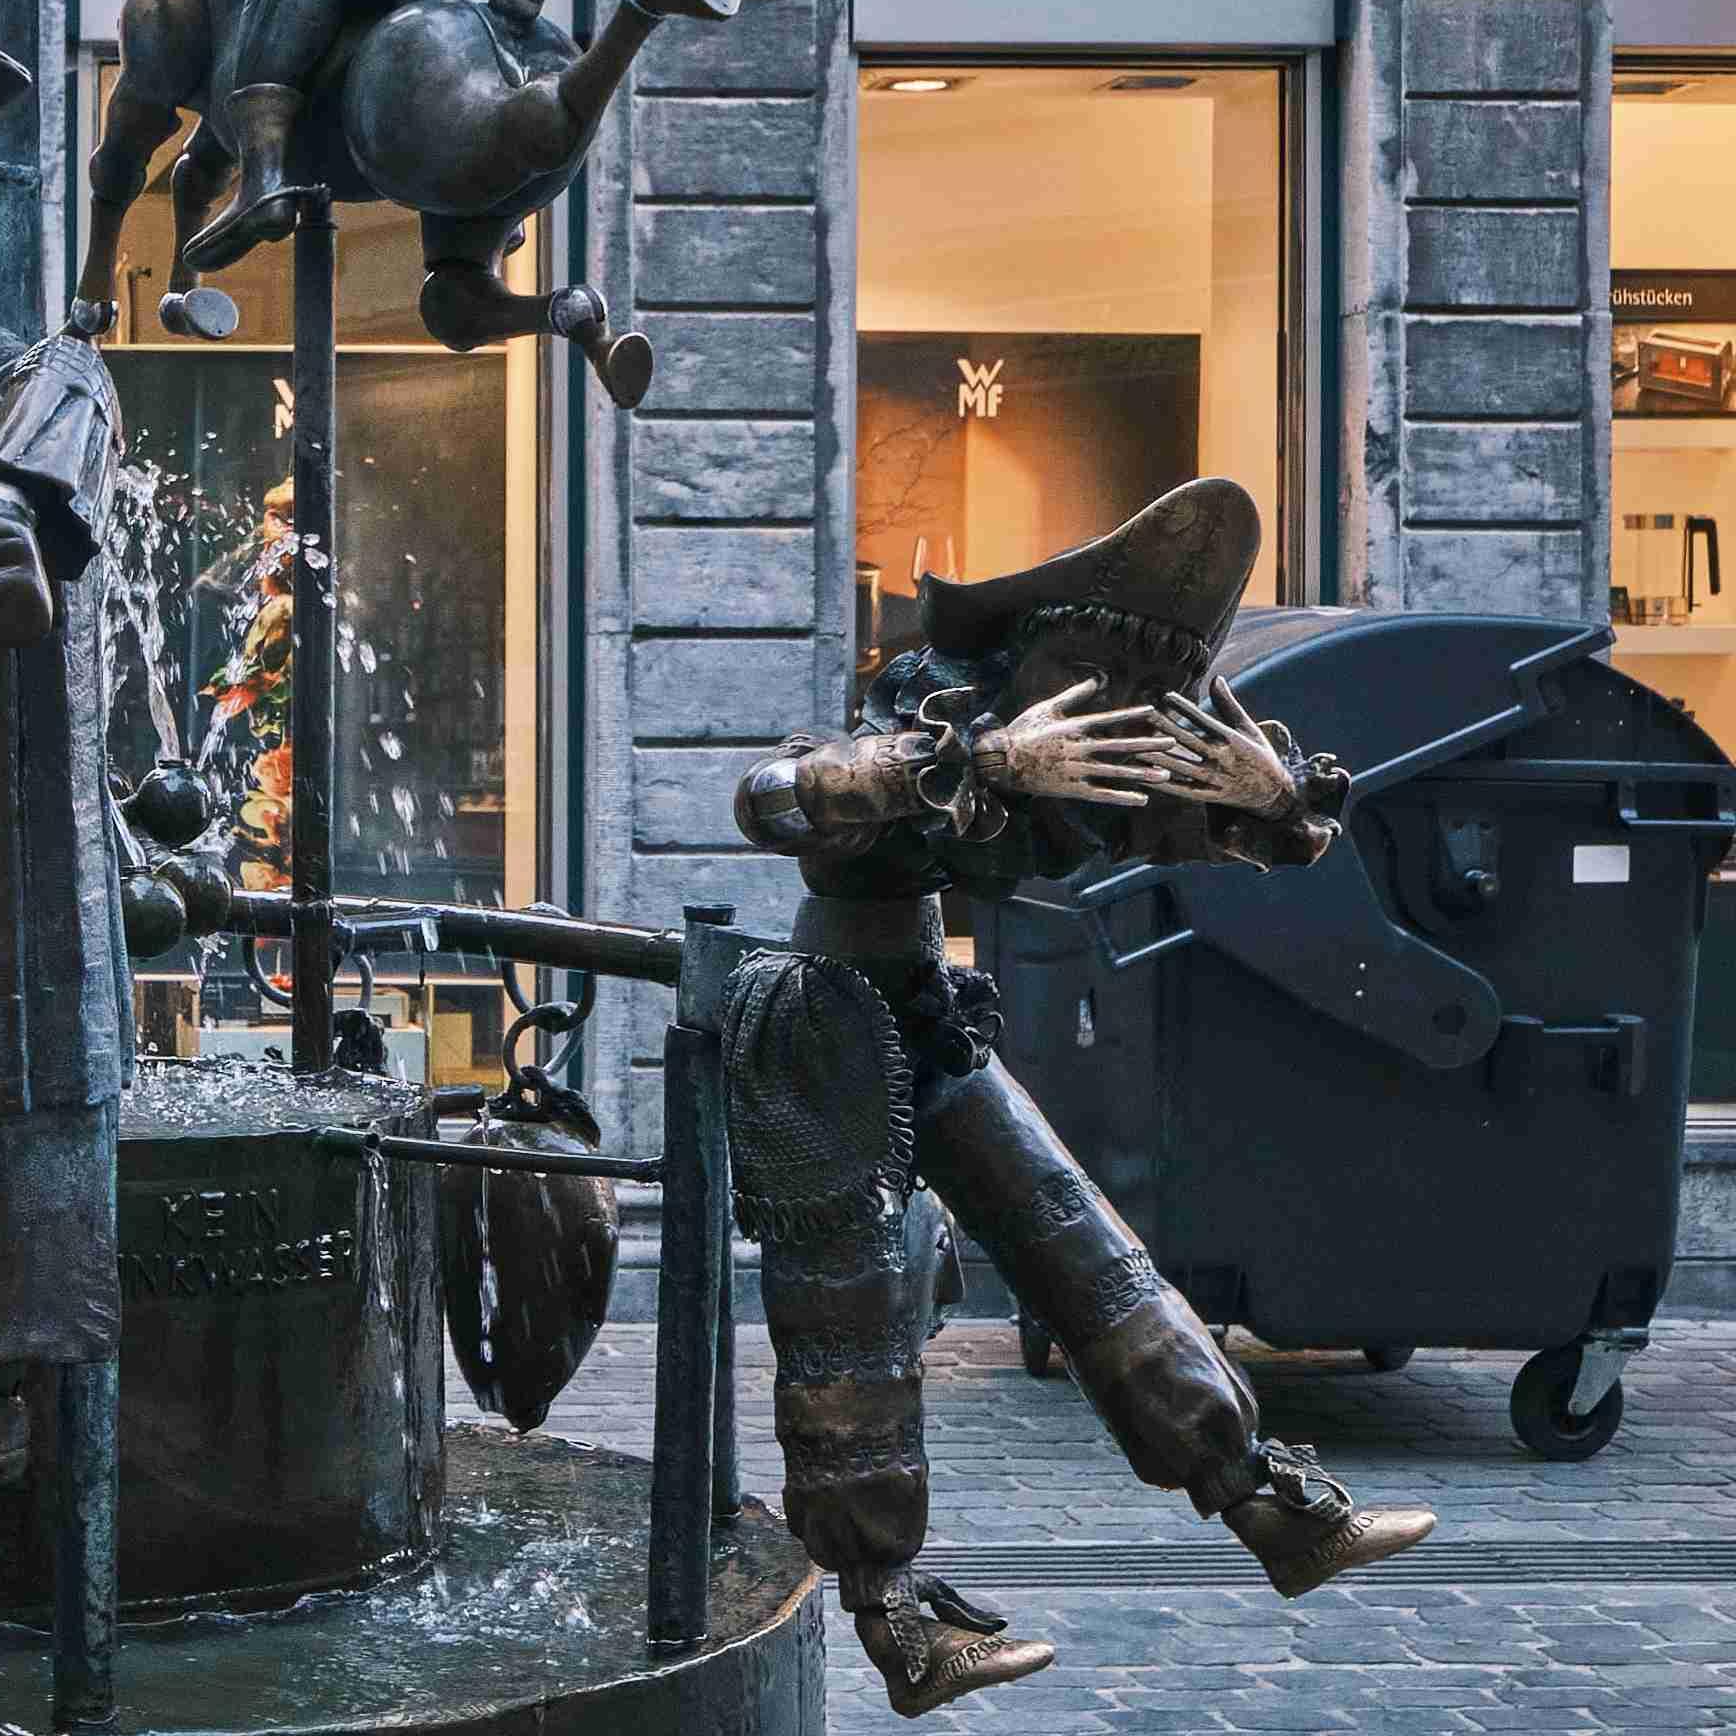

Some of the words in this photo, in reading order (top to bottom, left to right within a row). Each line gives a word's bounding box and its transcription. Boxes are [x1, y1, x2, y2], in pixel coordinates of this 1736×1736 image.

[1609, 288, 1693, 306] ühstücken
[957, 359, 1004, 418] WMF
[161, 1186, 280, 1241] KEIN
